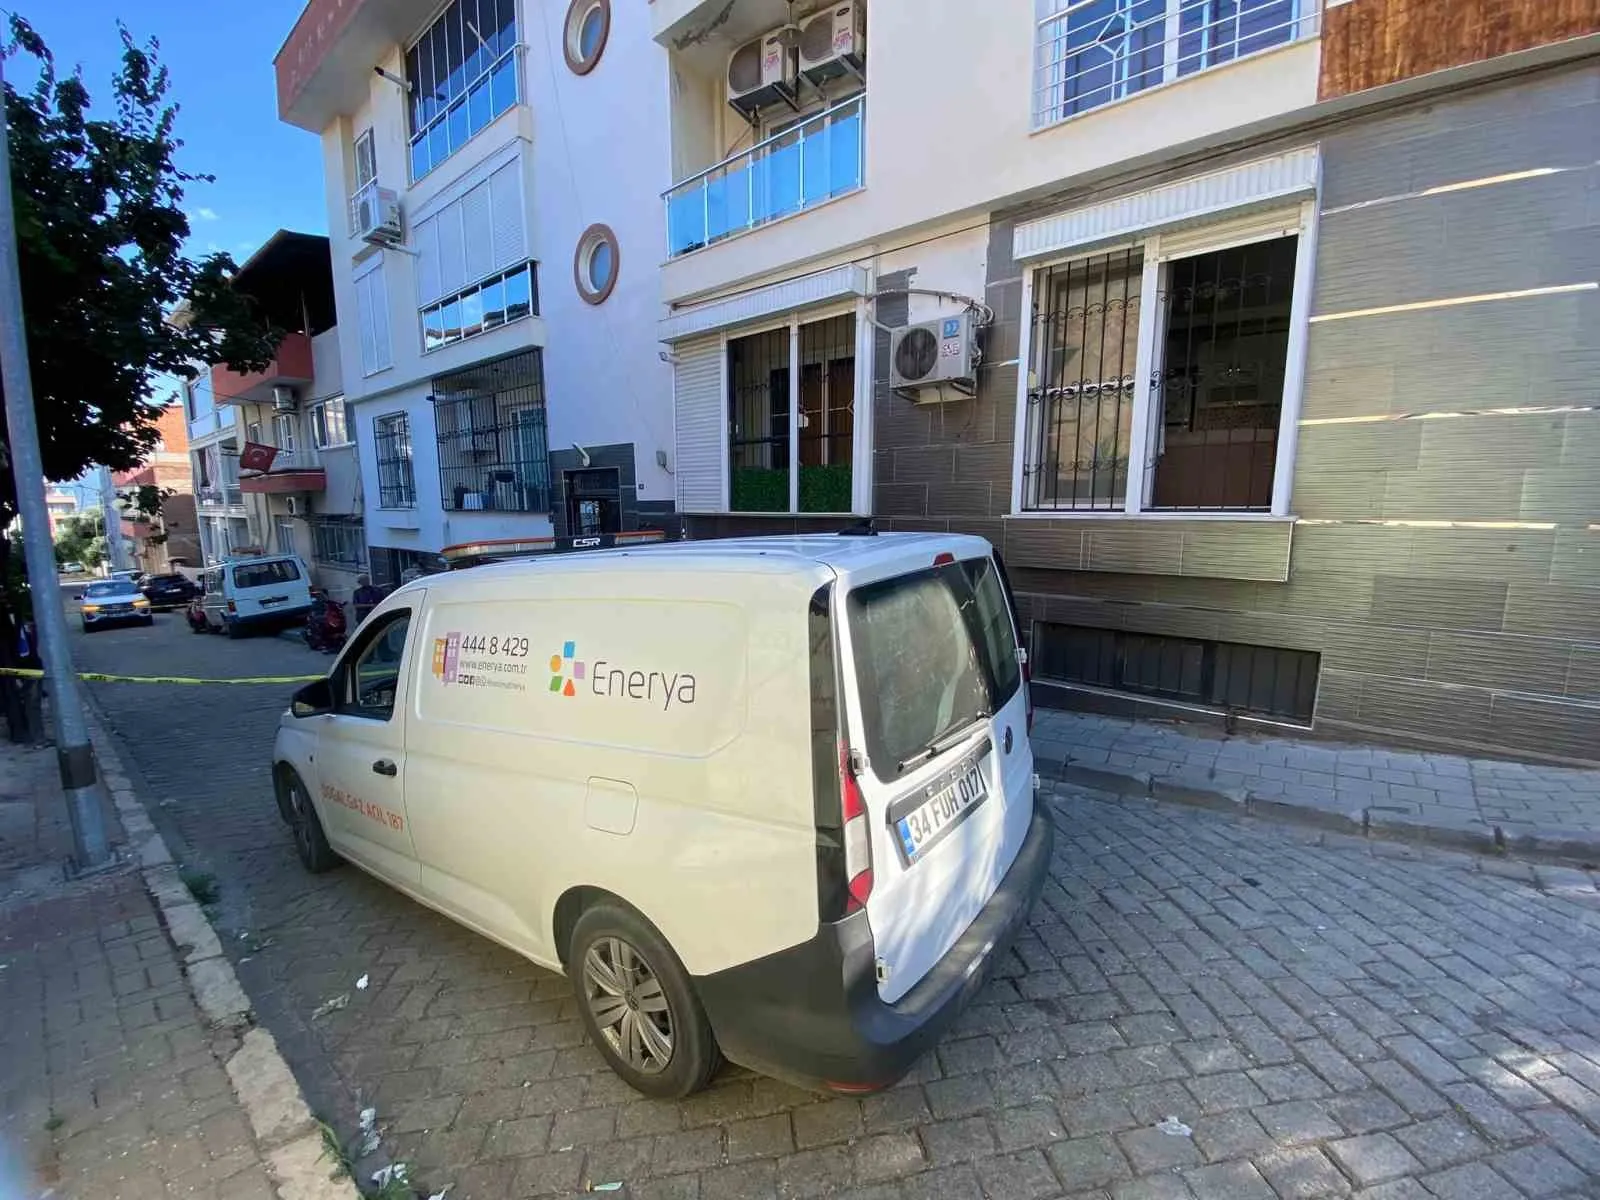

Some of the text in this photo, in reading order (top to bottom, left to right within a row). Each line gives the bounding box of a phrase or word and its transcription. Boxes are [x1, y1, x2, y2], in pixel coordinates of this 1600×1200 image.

[573, 538, 601, 548] CSR
[462, 635, 529, 657] 444 8 429
[460, 659, 528, 675] www.enerya.com.tr
[592, 661, 696, 711] Enerya
[910, 766, 980, 844] 34 FUH 017
[386, 811, 404, 832] 187
